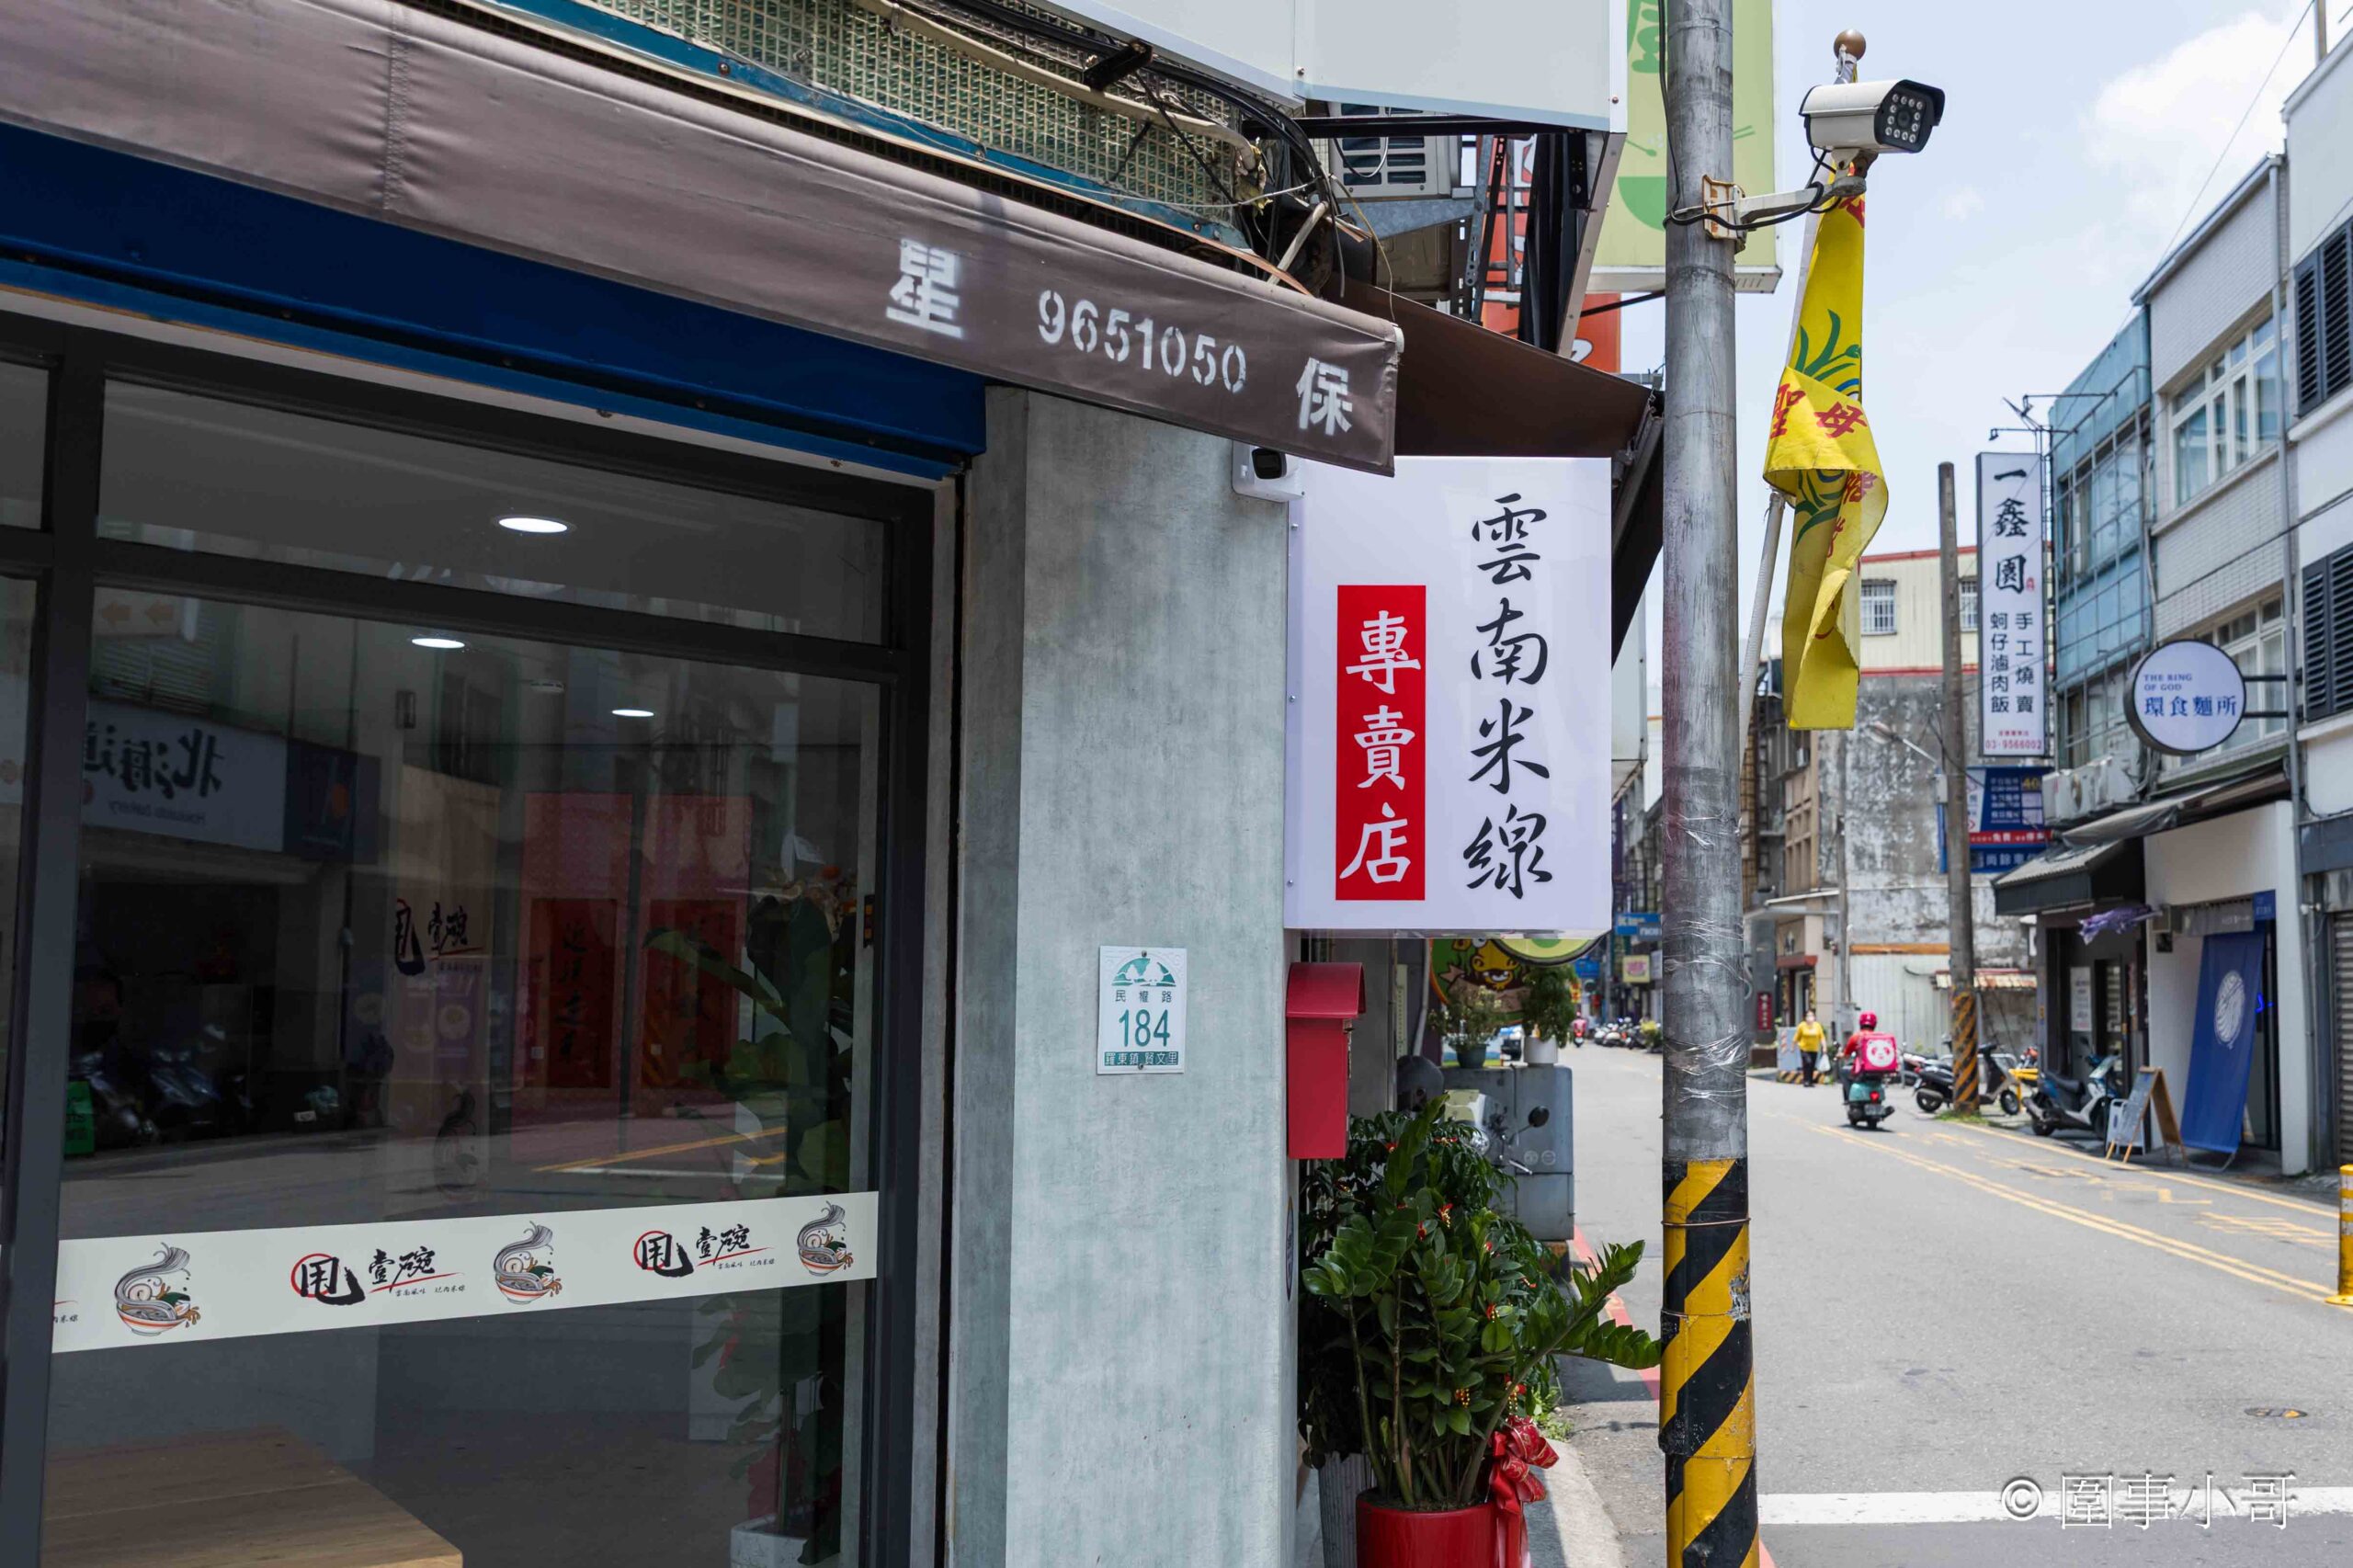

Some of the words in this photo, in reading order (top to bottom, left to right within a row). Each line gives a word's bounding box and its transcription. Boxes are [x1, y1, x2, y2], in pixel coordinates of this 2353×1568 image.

[886, 237, 963, 339] 星
[1038, 290, 1246, 392] 9651050
[1296, 357, 1353, 436] 保
[1462, 493, 1552, 900] 雲南米線
[1990, 612, 2009, 713] 蚵仔滷肉飯
[2015, 612, 2034, 713] 手工燒賣
[2143, 695, 2236, 717] 環食麵所
[2167, 673, 2192, 681] RING
[1339, 610, 1421, 883] 專賣店
[1115, 989, 1172, 1004] 民權路
[1119, 1009, 1170, 1047] 184
